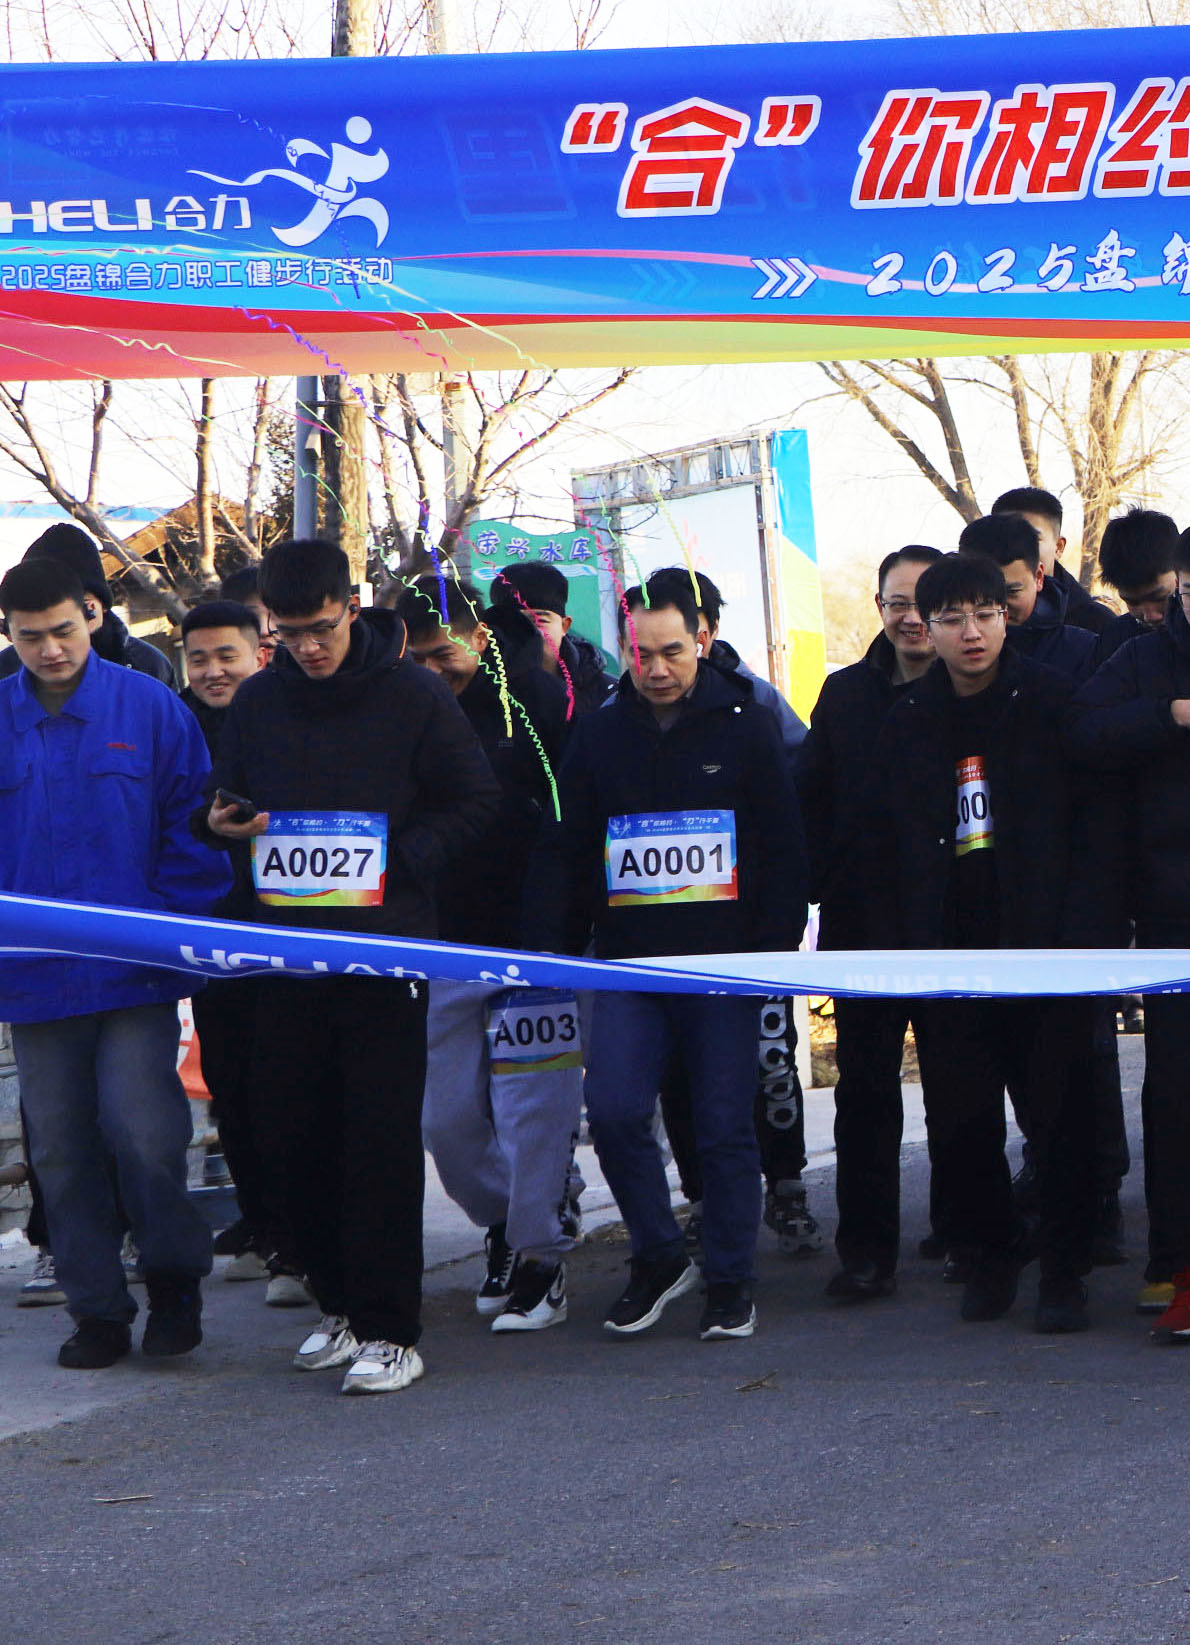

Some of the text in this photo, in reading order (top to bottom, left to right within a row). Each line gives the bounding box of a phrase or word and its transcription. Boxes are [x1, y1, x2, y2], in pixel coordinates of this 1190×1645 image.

[0, 194, 252, 234] HELI 合力
[1, 257, 393, 291] 2025盘锦合力职工健步行活动
[477, 531, 593, 561] 荣兴水库
[262, 847, 374, 877] A0027
[618, 843, 723, 878] A0001
[494, 1013, 576, 1047] A003
